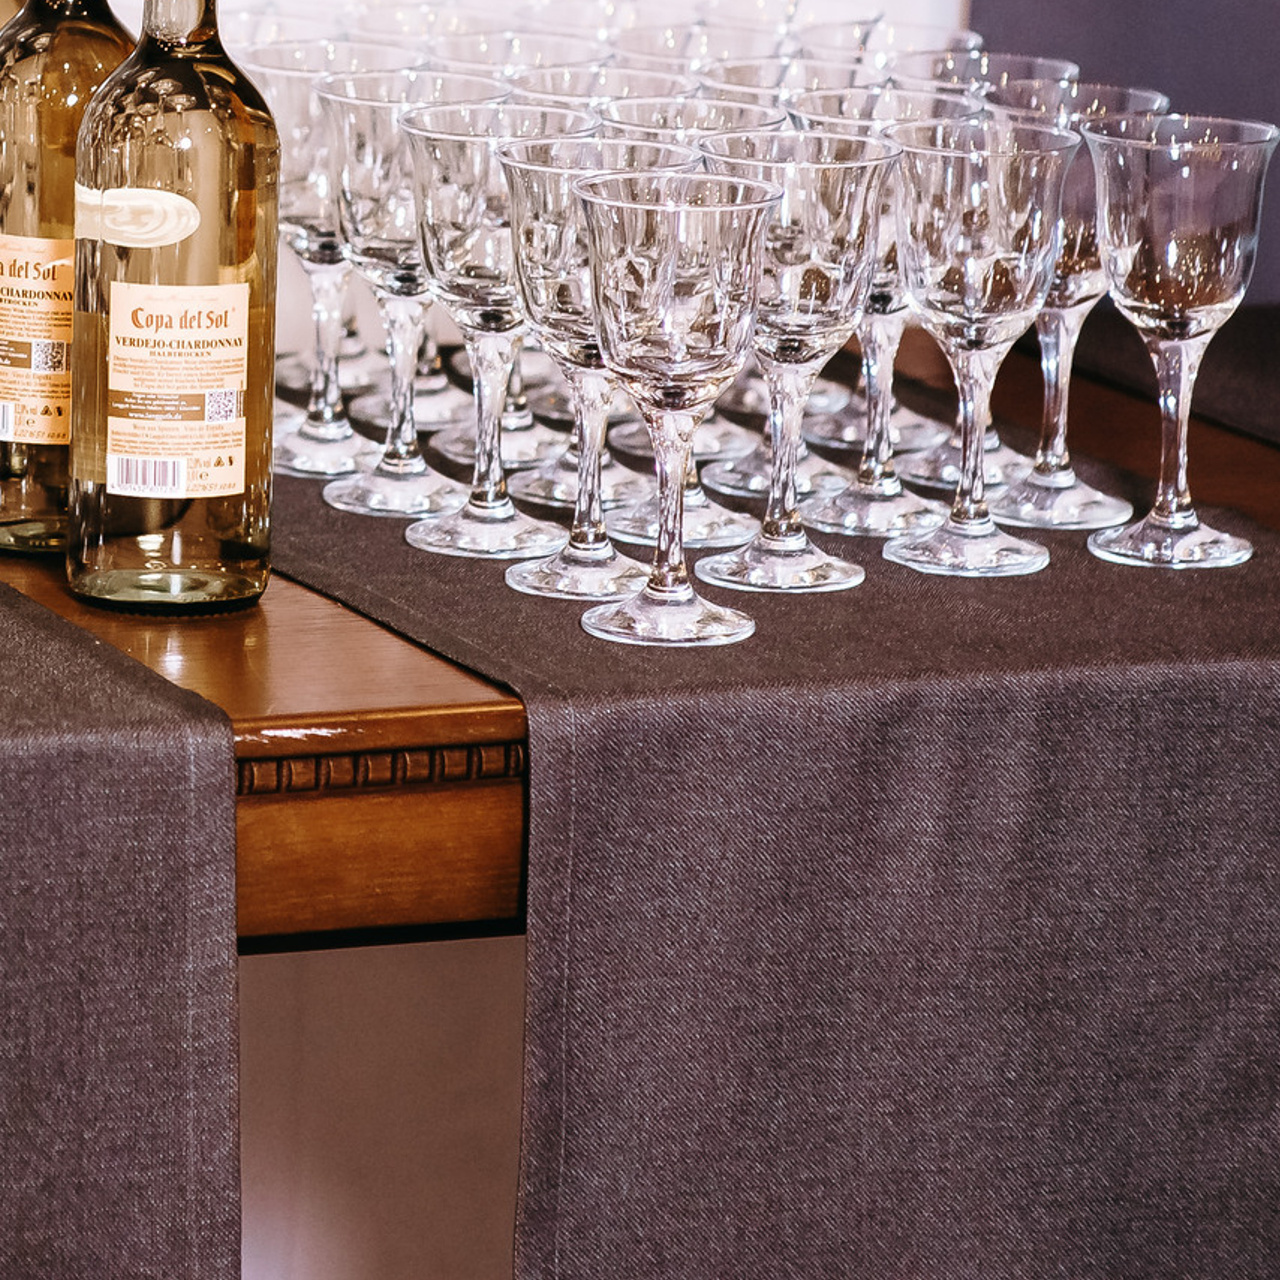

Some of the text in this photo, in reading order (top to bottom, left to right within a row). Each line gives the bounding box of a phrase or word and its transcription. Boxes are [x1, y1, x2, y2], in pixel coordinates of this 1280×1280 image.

[9, 259, 29, 279] del
[32, 262, 58, 281] Sol
[131, 307, 229, 334] Copa del Sol
[115, 336, 243, 349] VERDEJO-CHARDONNAY
